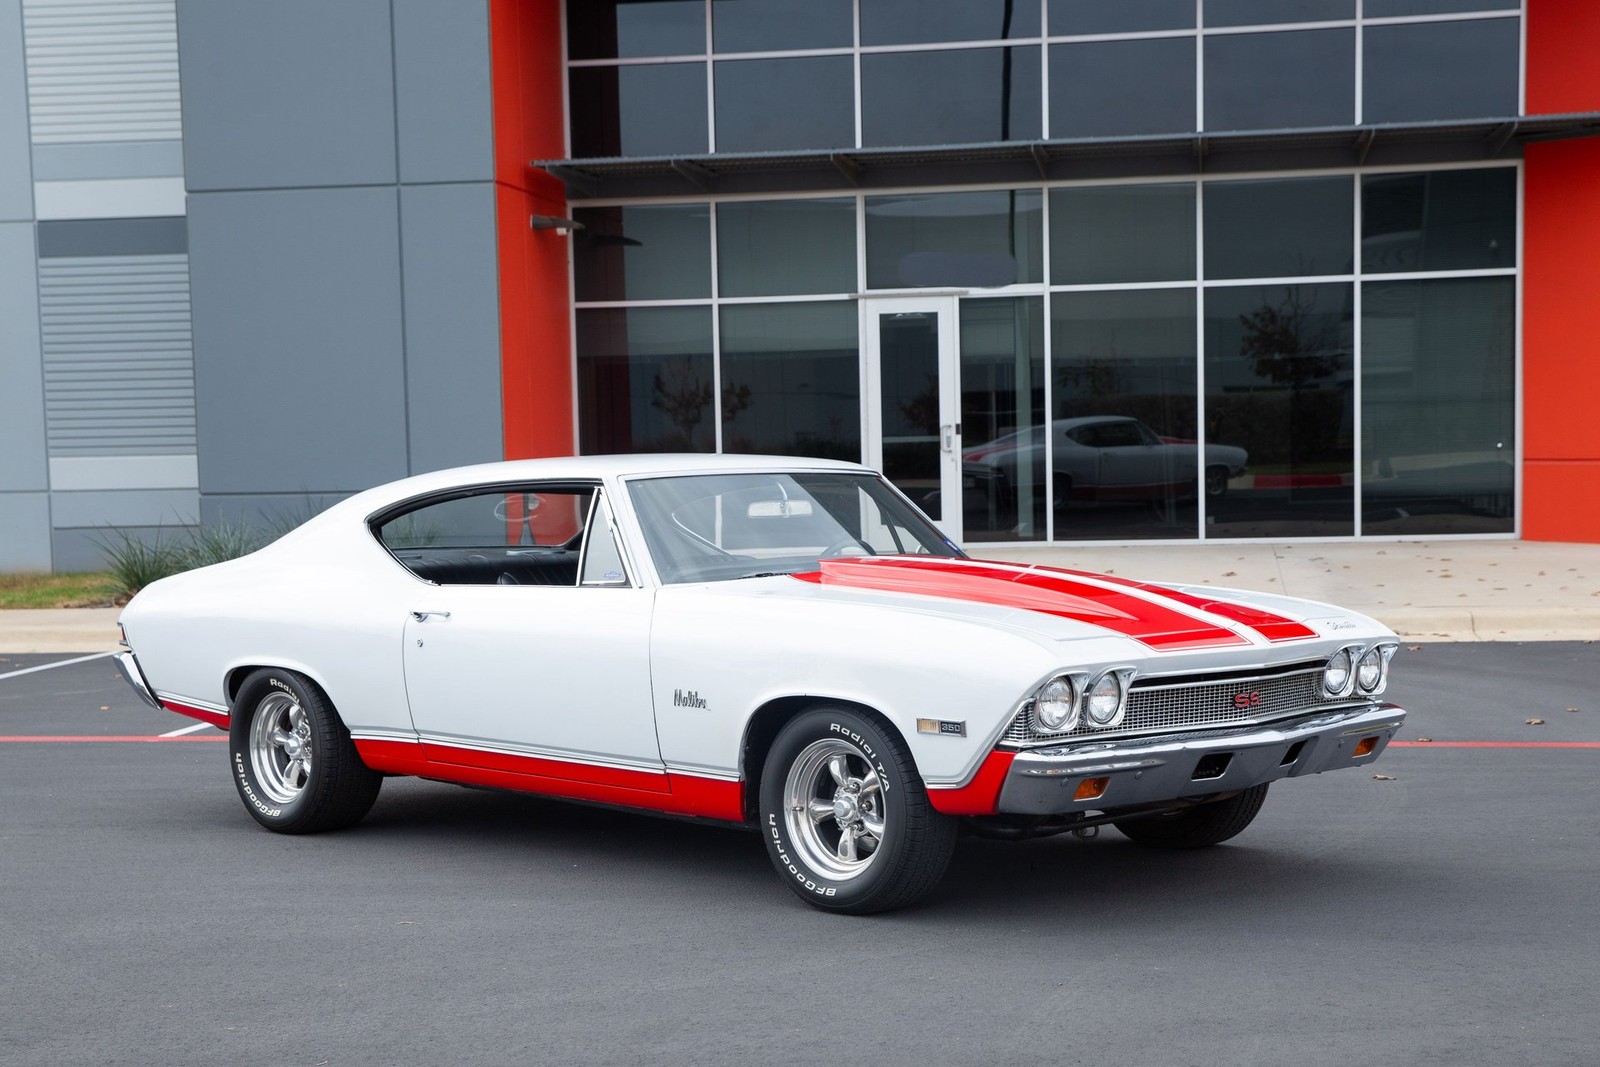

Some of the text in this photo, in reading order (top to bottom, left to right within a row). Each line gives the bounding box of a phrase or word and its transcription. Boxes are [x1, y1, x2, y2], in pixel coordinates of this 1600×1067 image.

[941, 723, 961, 732] 350
[1234, 691, 1261, 708] SS
[235, 752, 282, 817] BFGoodrich
[830, 723, 891, 792] Radial T/A
[768, 813, 837, 897] BFGoodrich
